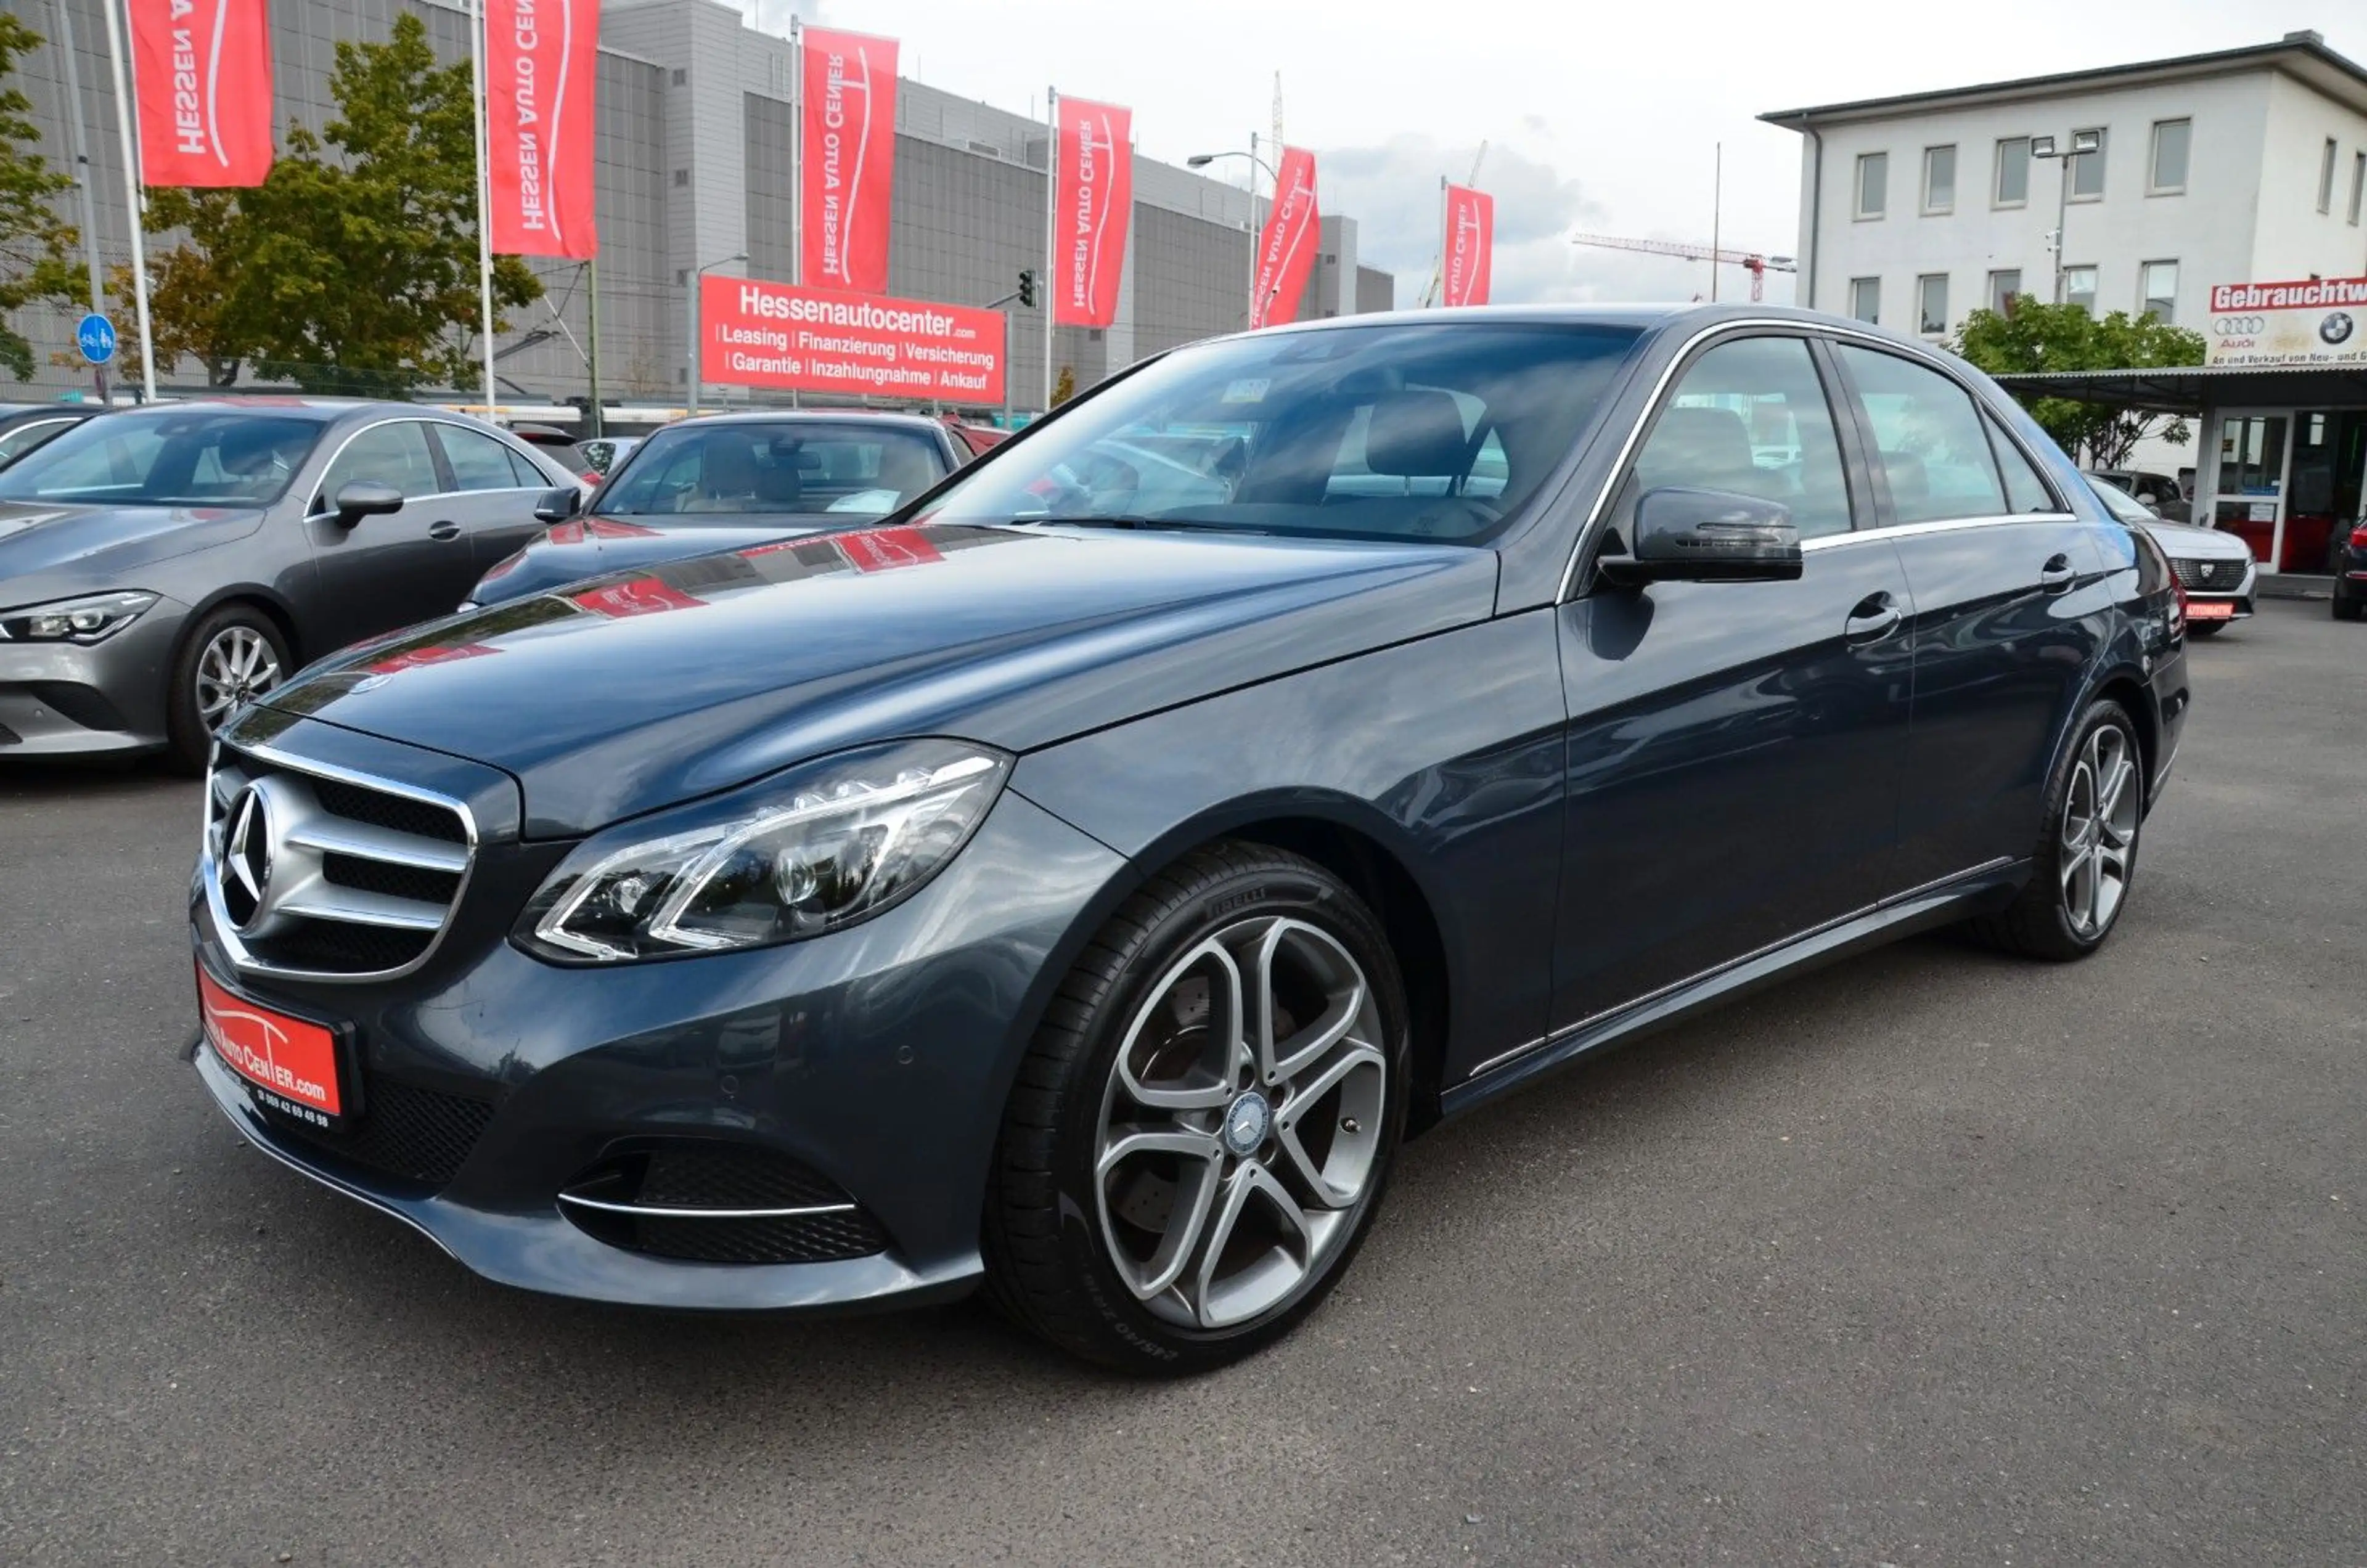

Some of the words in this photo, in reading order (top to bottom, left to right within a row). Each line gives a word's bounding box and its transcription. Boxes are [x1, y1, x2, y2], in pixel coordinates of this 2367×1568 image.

[722, 325, 787, 352] Leasing
[799, 331, 896, 361] Finanzierung
[905, 343, 994, 369] Versicherung
[2220, 338, 2255, 348] Audi
[2228, 354, 2245, 364] und
[2248, 353, 2285, 363] Verkauf
[2337, 352, 2357, 360] und
[732, 353, 801, 375] Garantie
[811, 359, 931, 386] Inzahlungnahme
[940, 372, 987, 390] Ankauf
